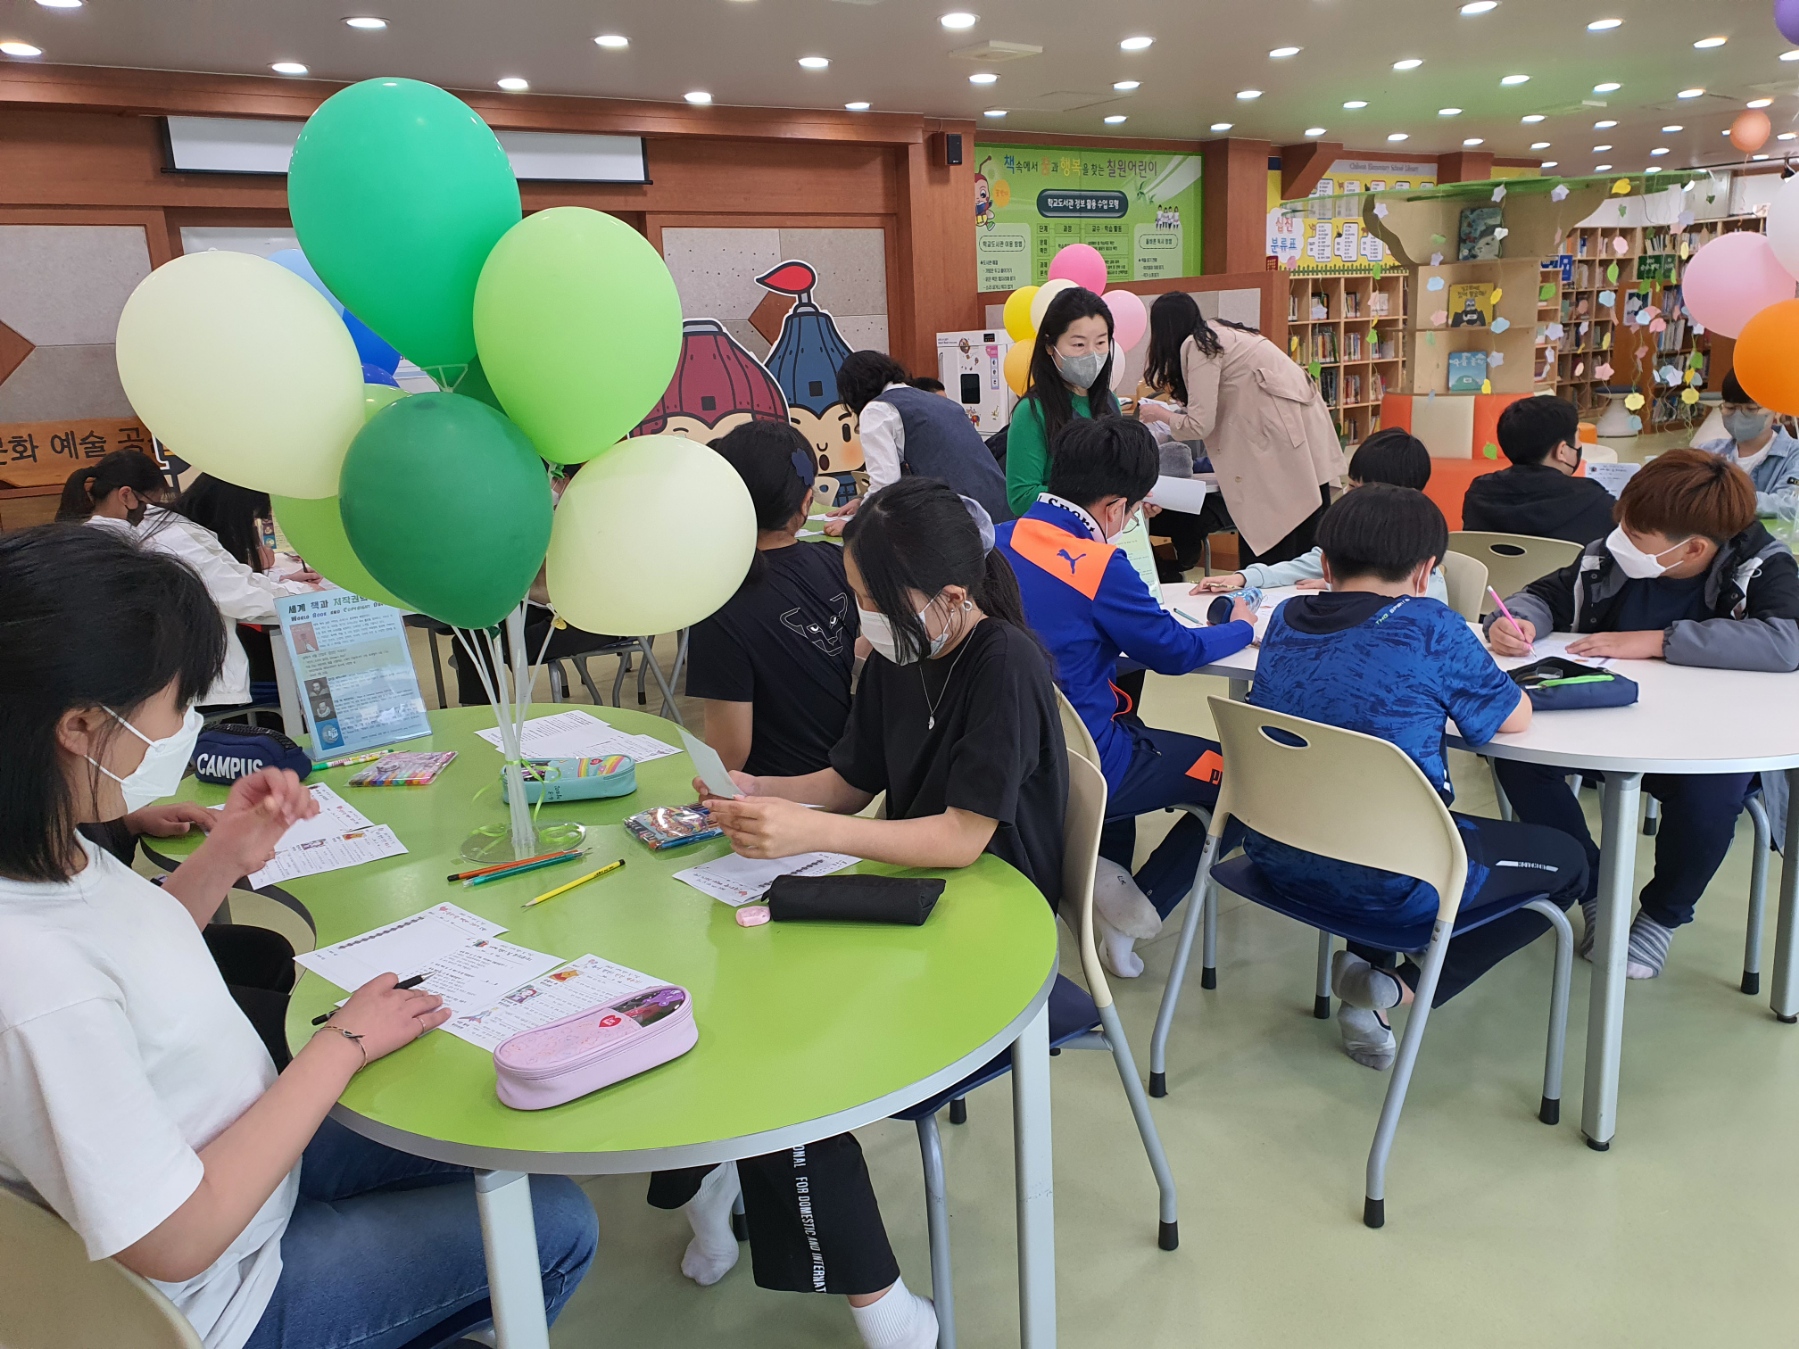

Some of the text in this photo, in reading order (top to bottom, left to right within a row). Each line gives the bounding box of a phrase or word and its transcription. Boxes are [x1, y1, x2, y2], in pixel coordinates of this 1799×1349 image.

[1091, 163, 1105, 176] 찾는
[1107, 158, 1158, 178] 칠원어린이
[1047, 198, 1074, 209] 학교도서관
[1075, 199, 1085, 209] 정보
[1086, 199, 1096, 210] 활용
[1097, 199, 1108, 210] 수업
[1276, 217, 1294, 233] 십진
[1271, 237, 1297, 254] 분류표
[0, 427, 155, 466] 화 예술 공
[288, 603, 306, 614] 세계
[310, 600, 329, 610] 책과
[196, 753, 263, 779] CAMPUS
[795, 1176, 809, 1193] FOR
[798, 1196, 816, 1236] DOMESTIC
[807, 1236, 821, 1252] AND
[812, 1253, 827, 1293] INTERNAT
